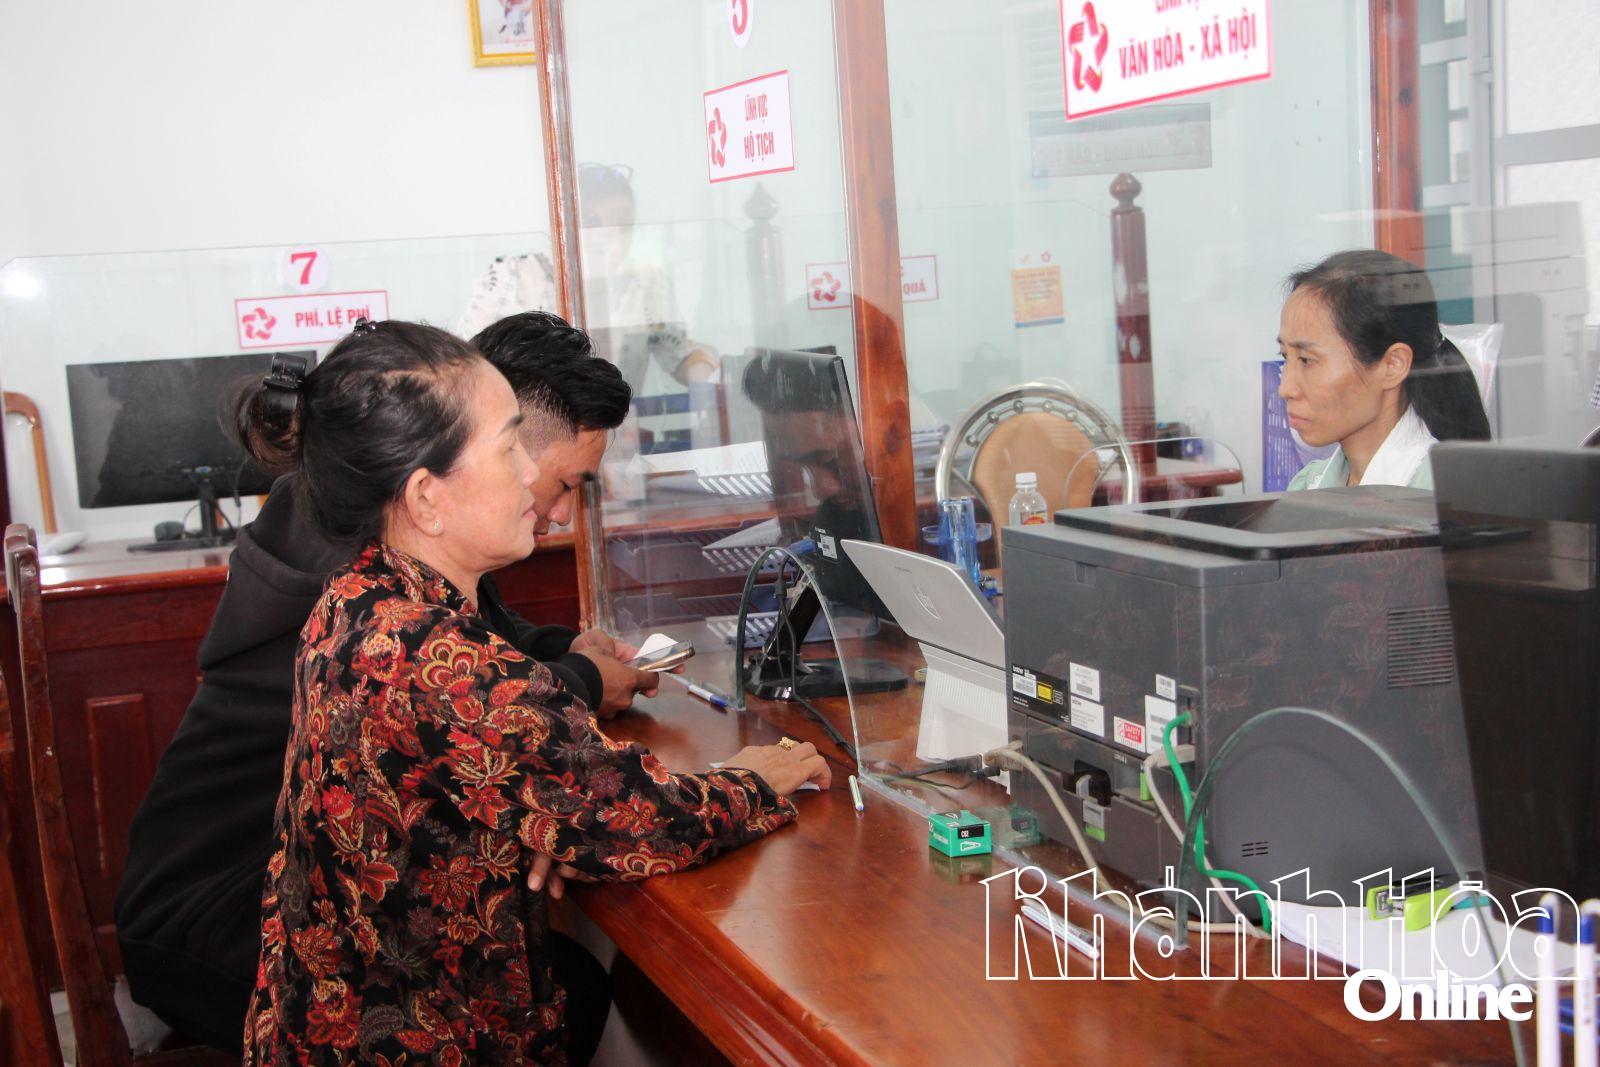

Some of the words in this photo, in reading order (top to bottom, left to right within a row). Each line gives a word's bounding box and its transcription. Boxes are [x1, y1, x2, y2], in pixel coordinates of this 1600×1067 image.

[732, 0, 748, 35] 5
[1119, 38, 1148, 79] VĂN
[1153, 29, 1184, 71] HÓA
[1201, 15, 1222, 60] XÃ
[1228, 7, 1257, 60] HỘI
[745, 94, 758, 121] LĨNH
[757, 93, 769, 123] VỰC
[744, 131, 755, 163] HỘ
[756, 131, 775, 161] TỊCH
[290, 251, 318, 285] 7
[295, 307, 323, 328] PHÍ,
[327, 306, 343, 328] LỆ
